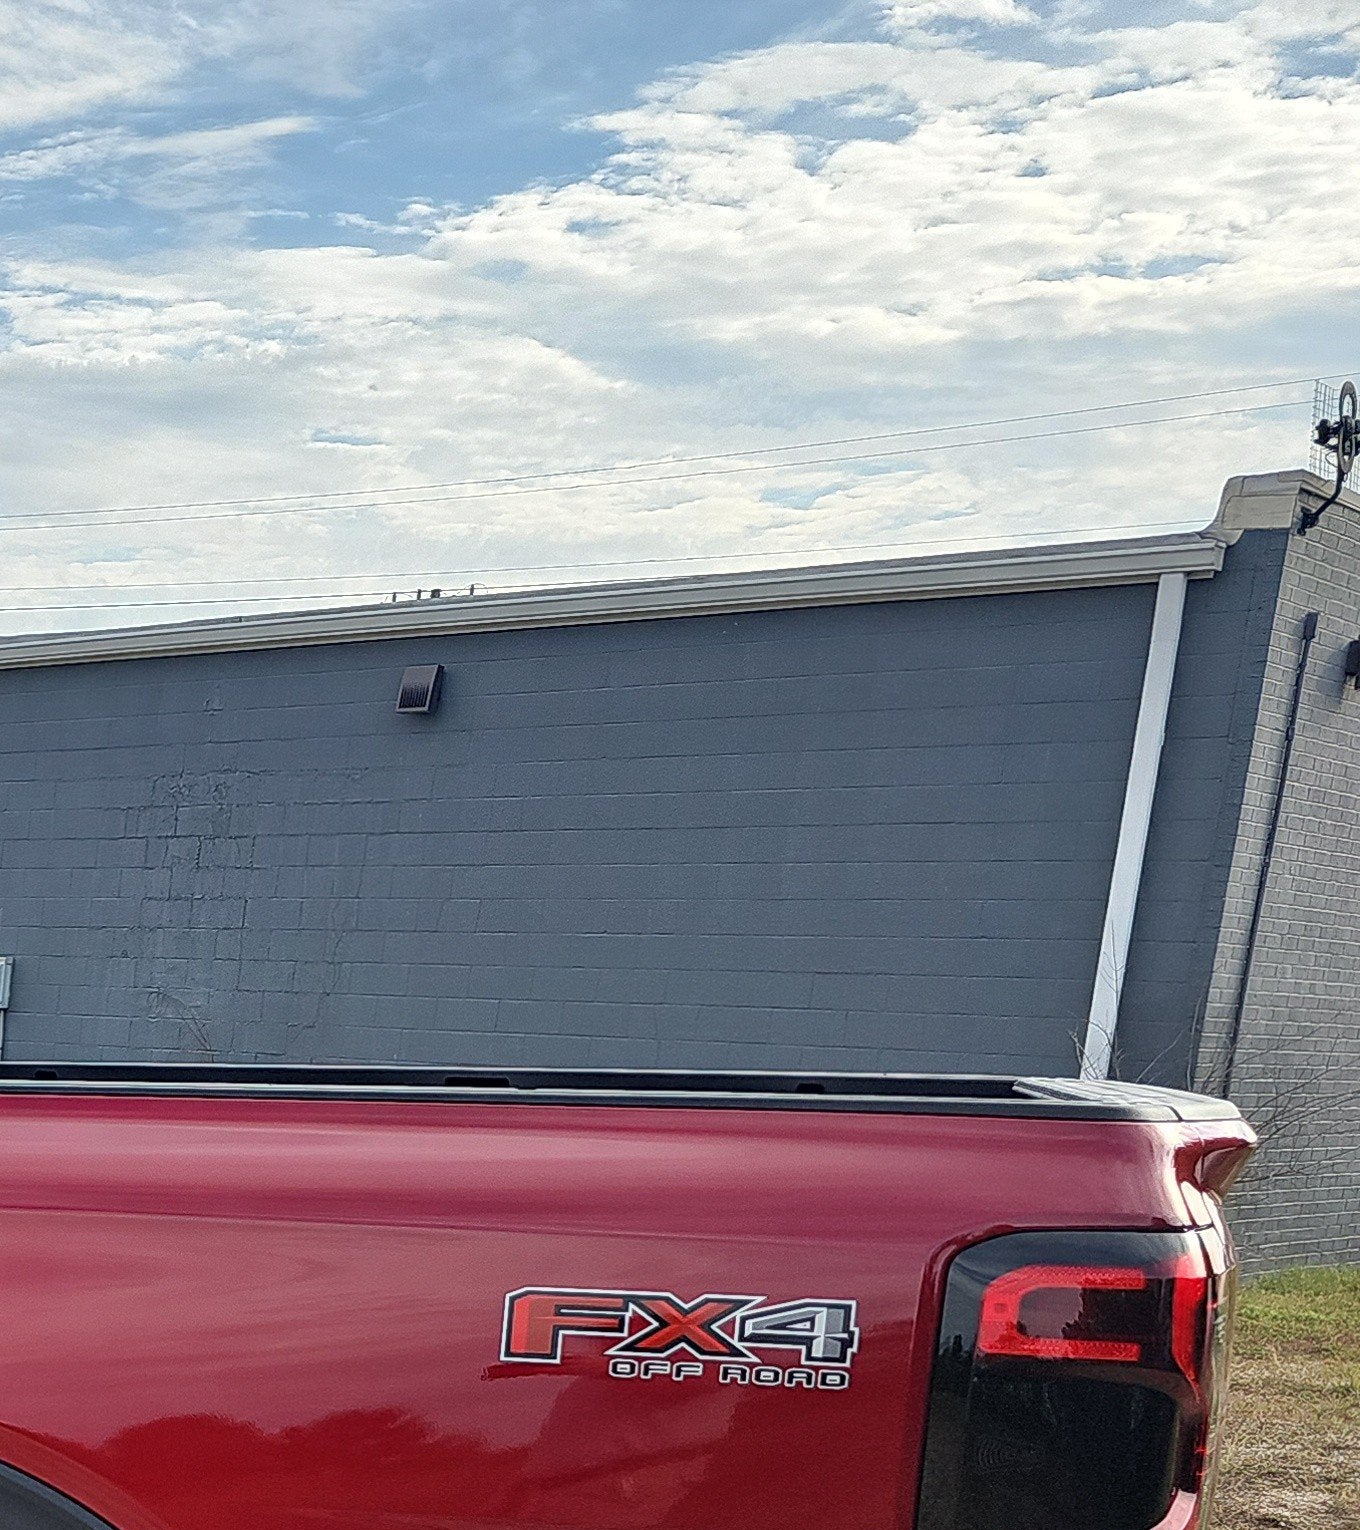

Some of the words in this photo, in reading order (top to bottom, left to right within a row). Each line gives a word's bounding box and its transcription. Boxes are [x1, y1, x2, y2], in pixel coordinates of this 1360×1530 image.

[499, 1286, 861, 1368] FX4
[609, 1359, 704, 1382] OFF
[718, 1365, 851, 1391] ROAD
